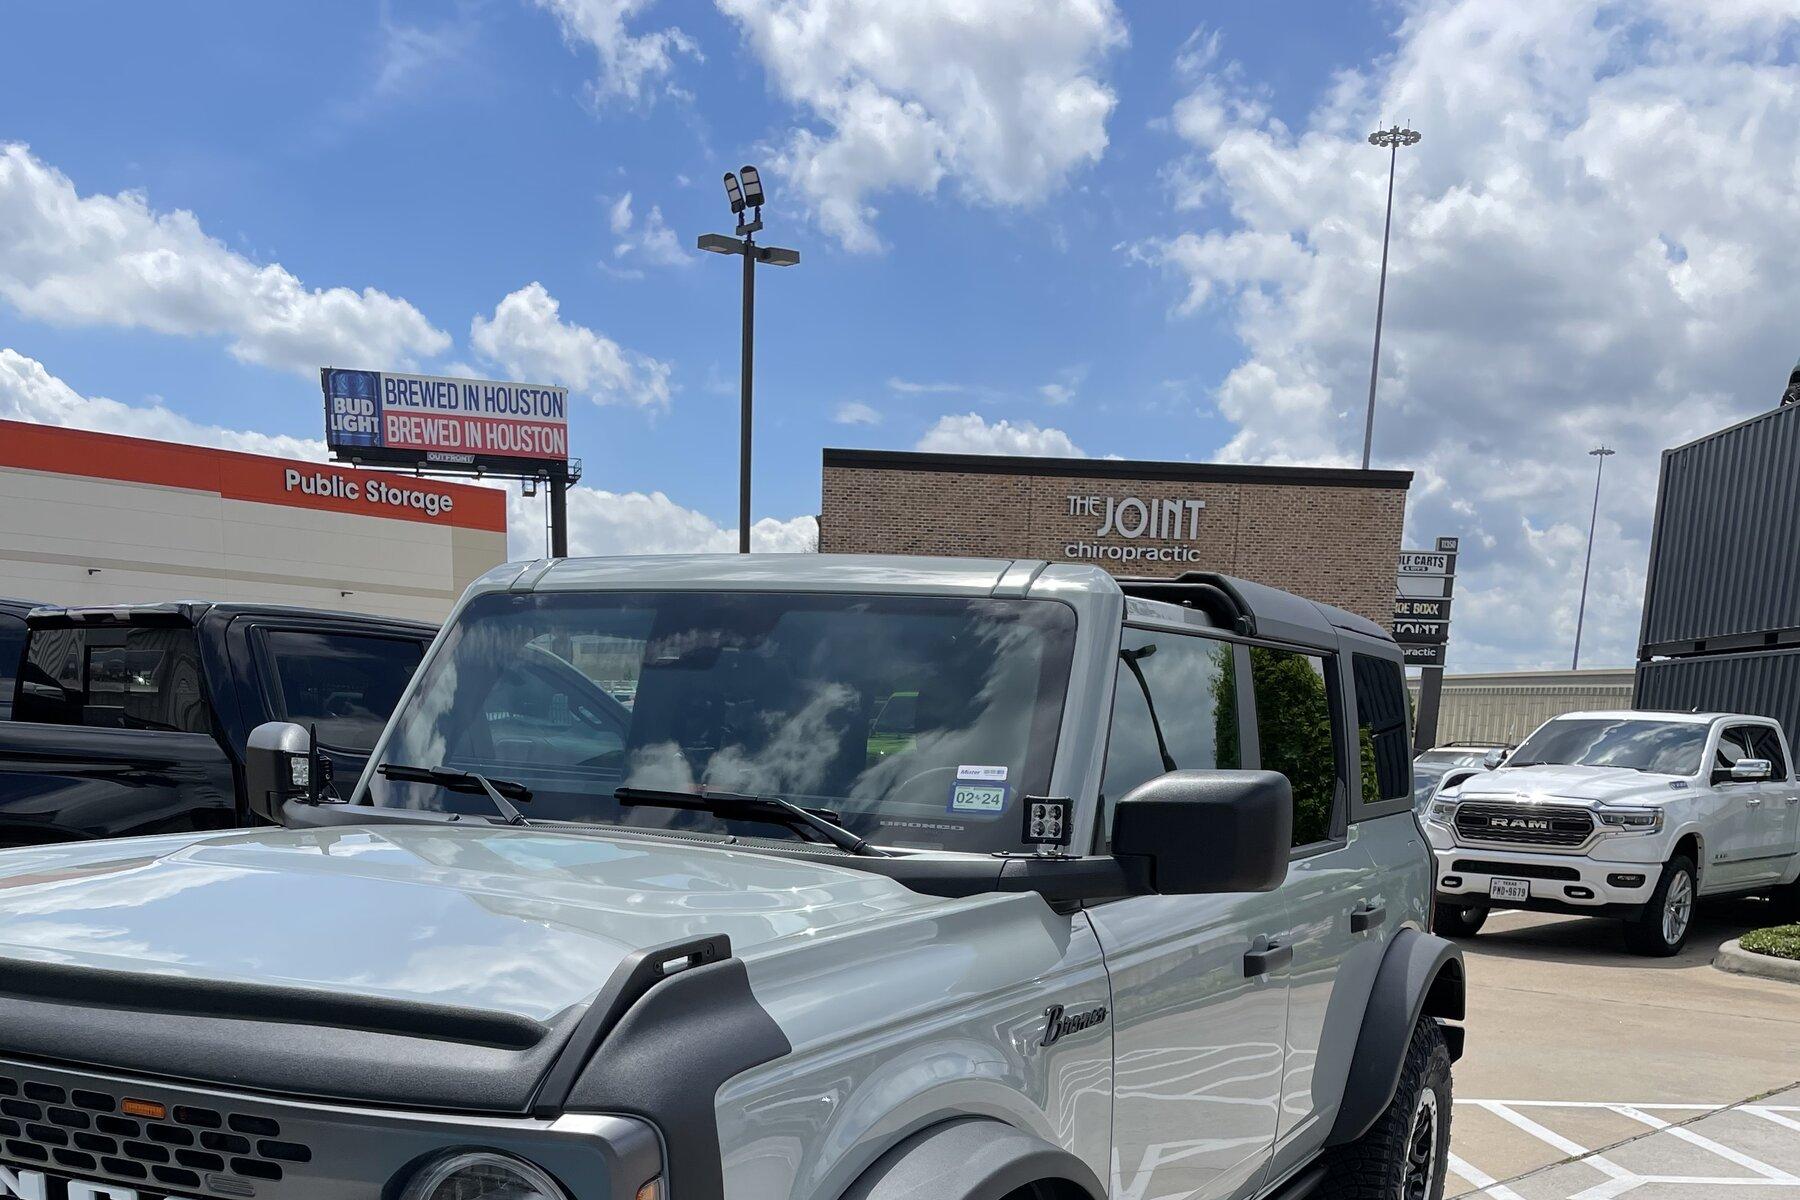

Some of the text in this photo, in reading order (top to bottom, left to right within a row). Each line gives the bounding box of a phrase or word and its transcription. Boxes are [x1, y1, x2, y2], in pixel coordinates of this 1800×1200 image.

[333, 397, 375, 416] BUD
[385, 377, 564, 419] BREWED IN HOUSTON
[331, 414, 379, 433] LIGHT
[386, 415, 566, 455] BREWED IN HOUSTON
[285, 469, 454, 517] Public Storage
[1066, 495, 1206, 541] THE JOINT
[1064, 541, 1201, 563] chiropractic
[1414, 556, 1444, 569] CARTS
[1412, 603, 1439, 615] BOXX
[1490, 818, 1549, 830] RAM
[1040, 1004, 1108, 1047] Bronco
